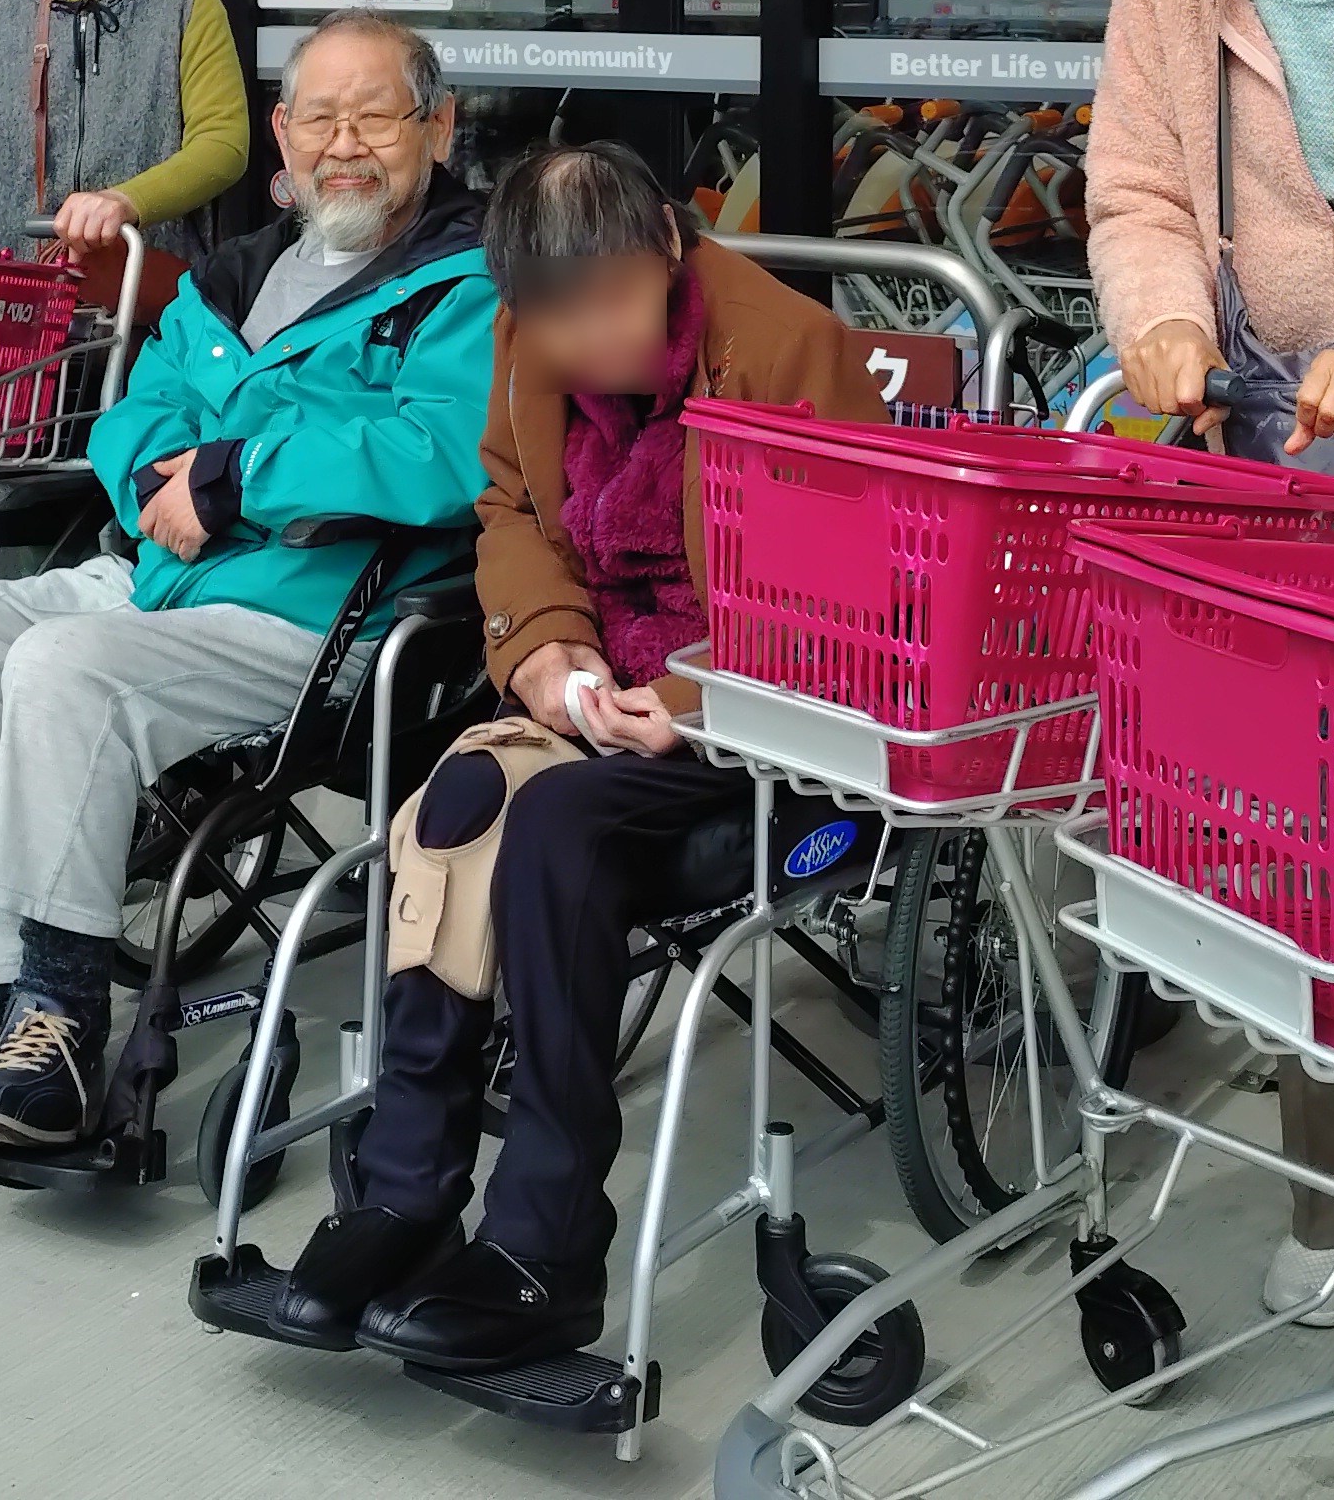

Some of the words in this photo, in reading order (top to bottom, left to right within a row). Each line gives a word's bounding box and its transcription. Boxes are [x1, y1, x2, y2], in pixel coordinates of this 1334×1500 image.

[463, 42, 517, 66] with
[524, 43, 673, 75] Community
[890, 53, 982, 77] Better
[991, 54, 1047, 79] Life
[1055, 56, 1104, 79] wit
